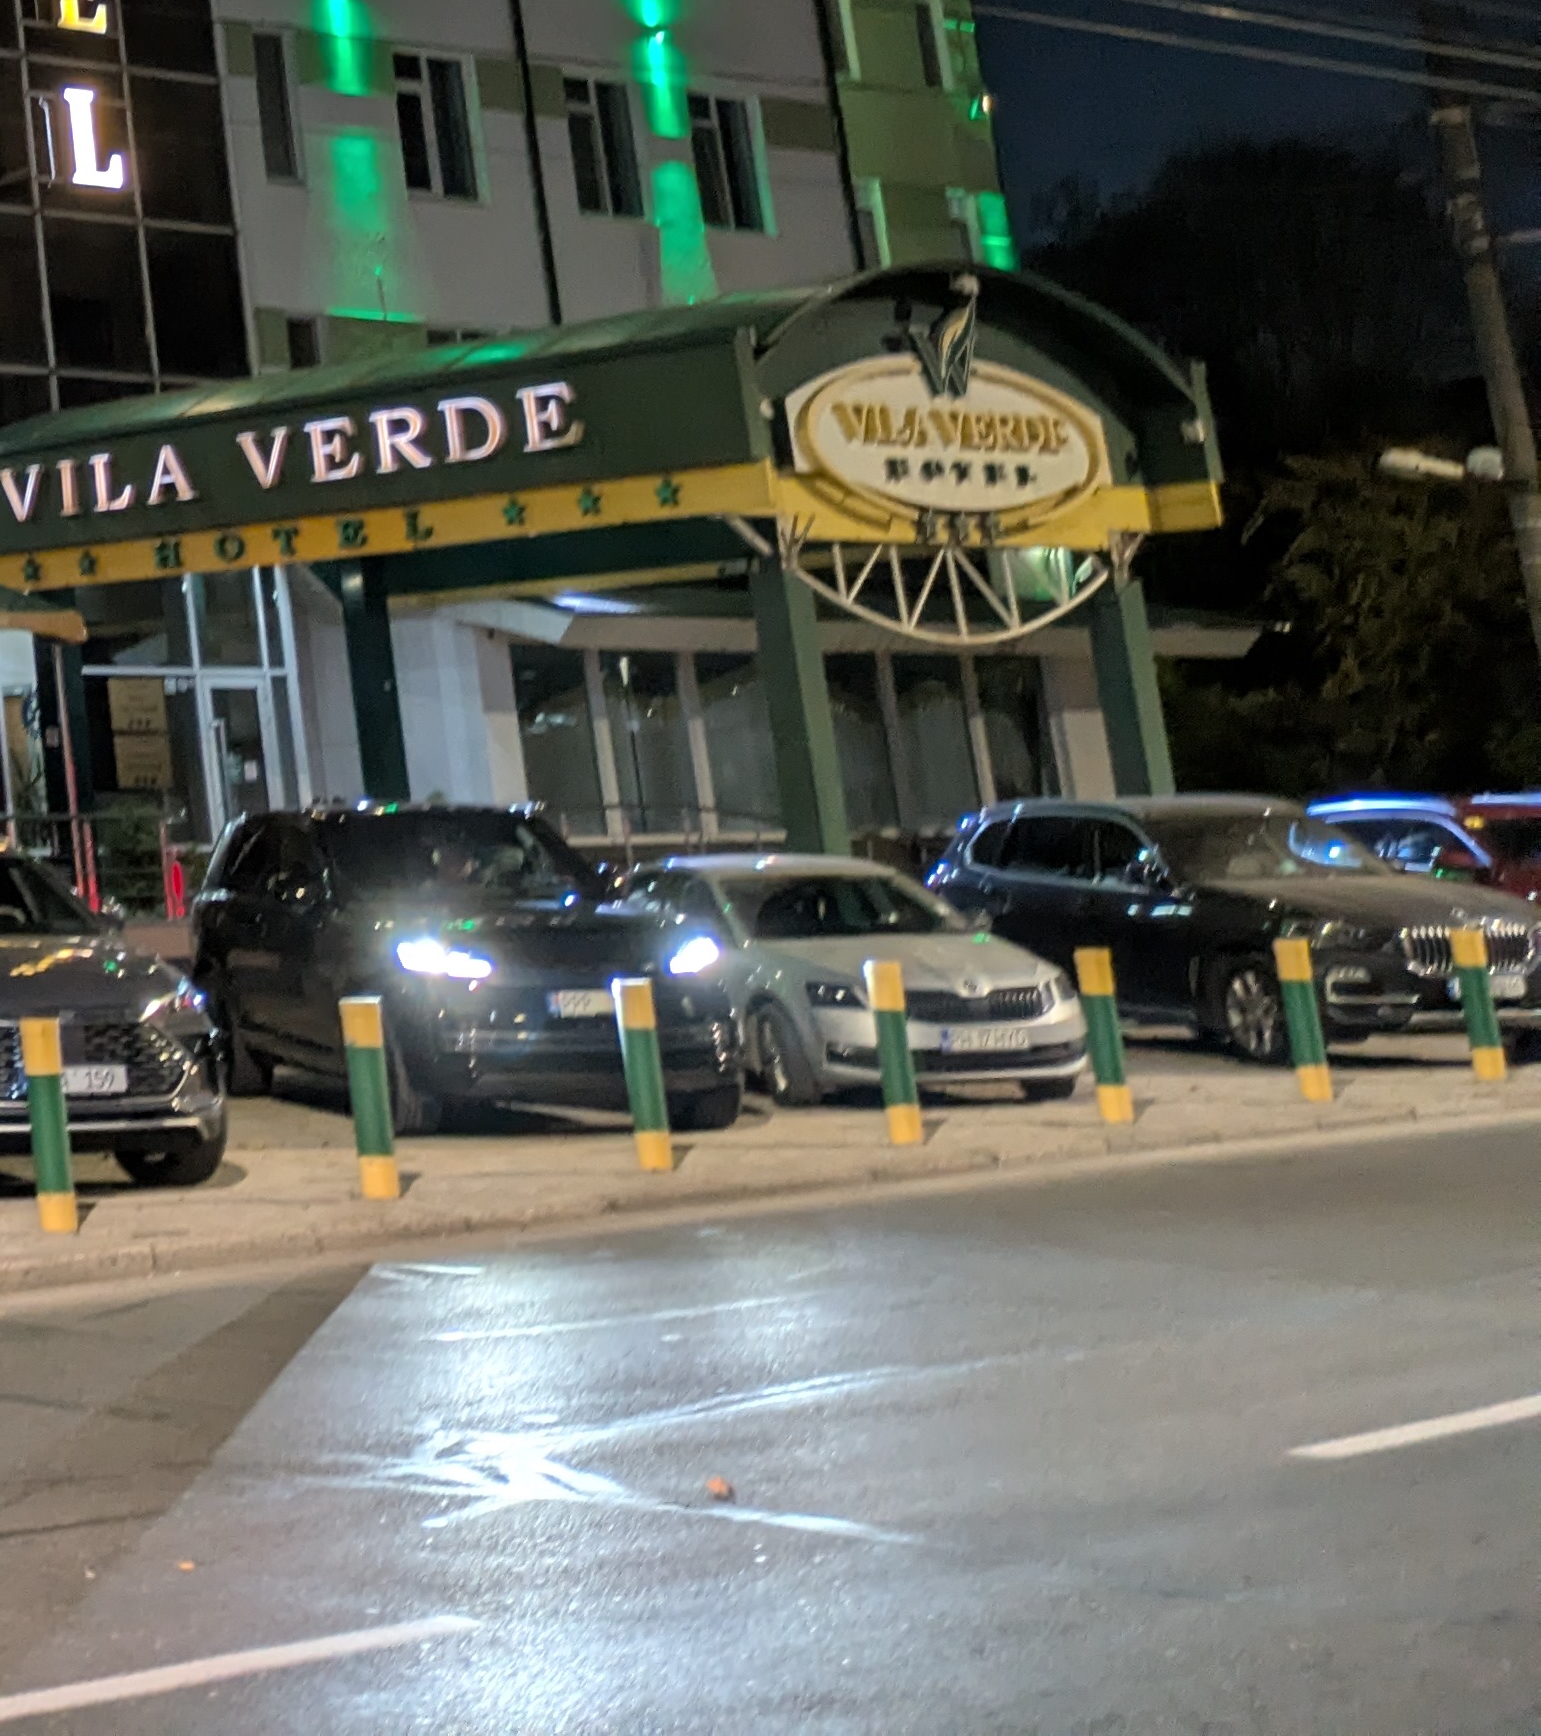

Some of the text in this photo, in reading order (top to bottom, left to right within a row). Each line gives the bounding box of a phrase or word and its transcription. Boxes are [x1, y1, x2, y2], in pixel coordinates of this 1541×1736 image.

[236, 380, 586, 491] VERDE
[831, 402, 1069, 456] VILA VERDE
[154, 506, 434, 568] HOTEL
